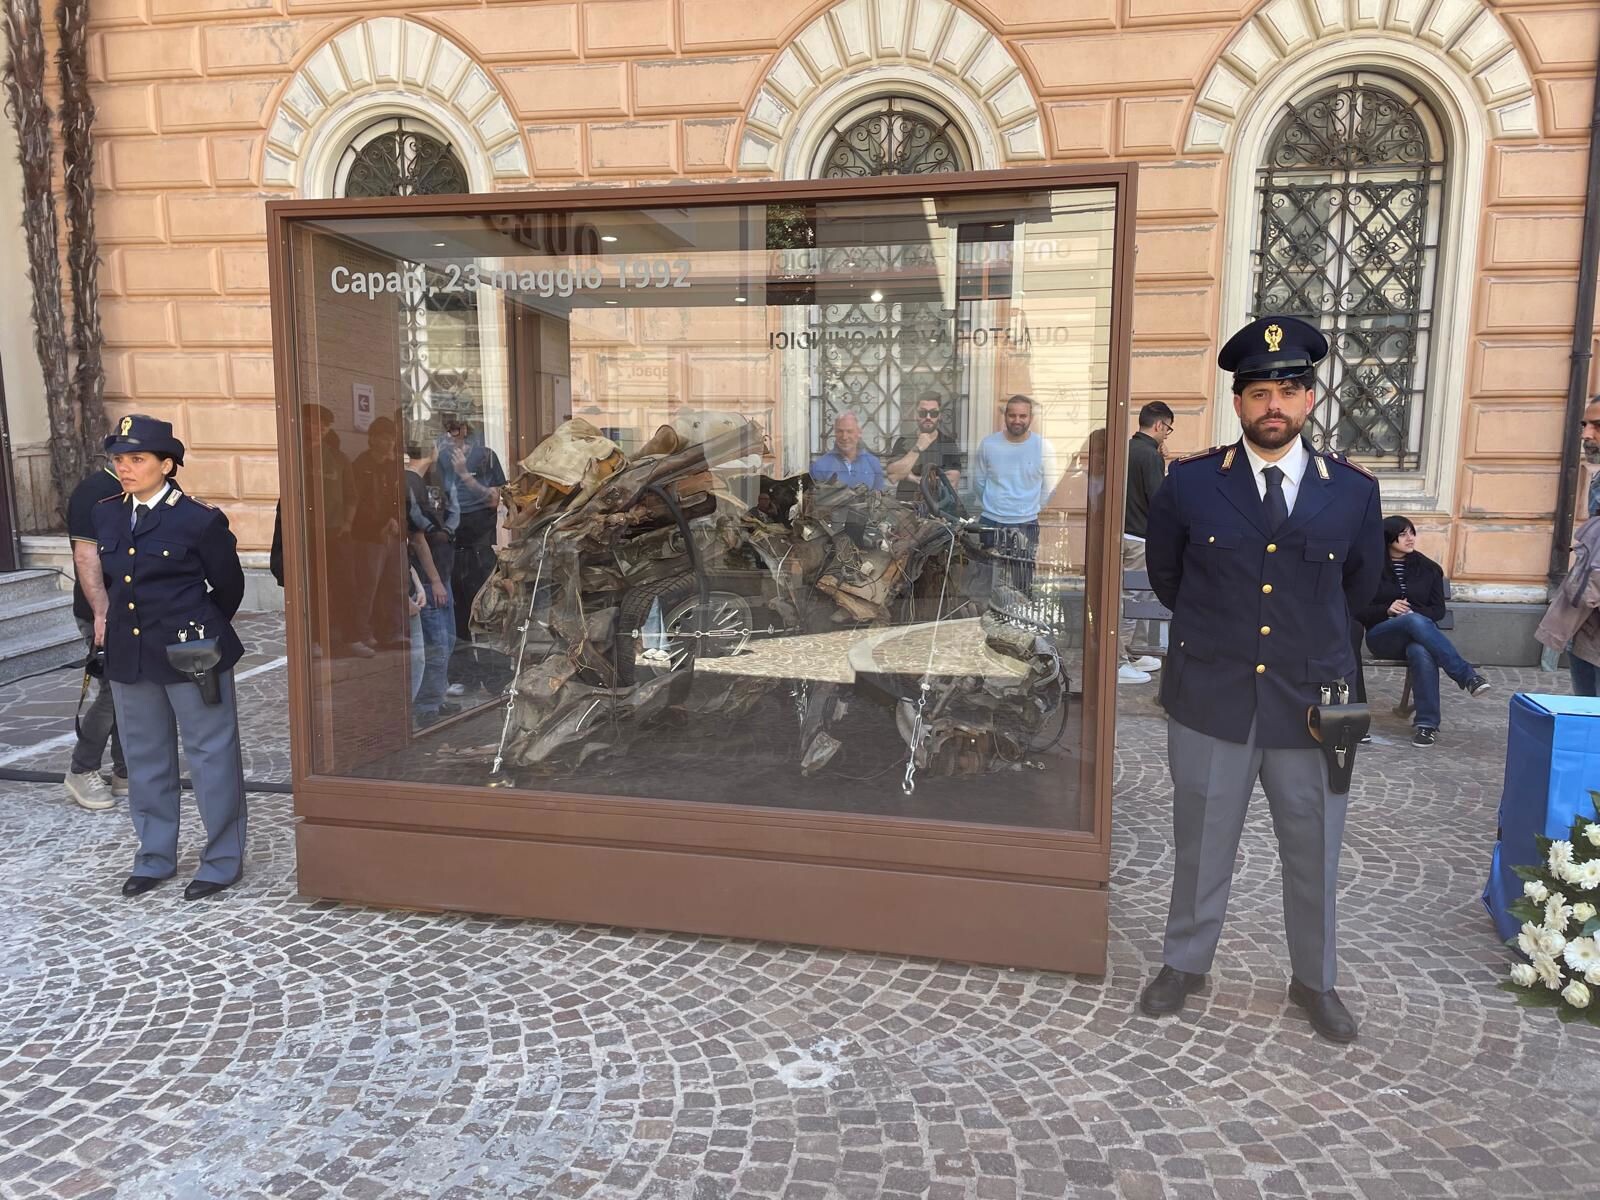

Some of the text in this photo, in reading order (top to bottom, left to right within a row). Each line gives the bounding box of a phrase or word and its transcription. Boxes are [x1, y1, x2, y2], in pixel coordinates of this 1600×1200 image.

[331, 258, 692, 300] Capaci, 23 maggio 1992
